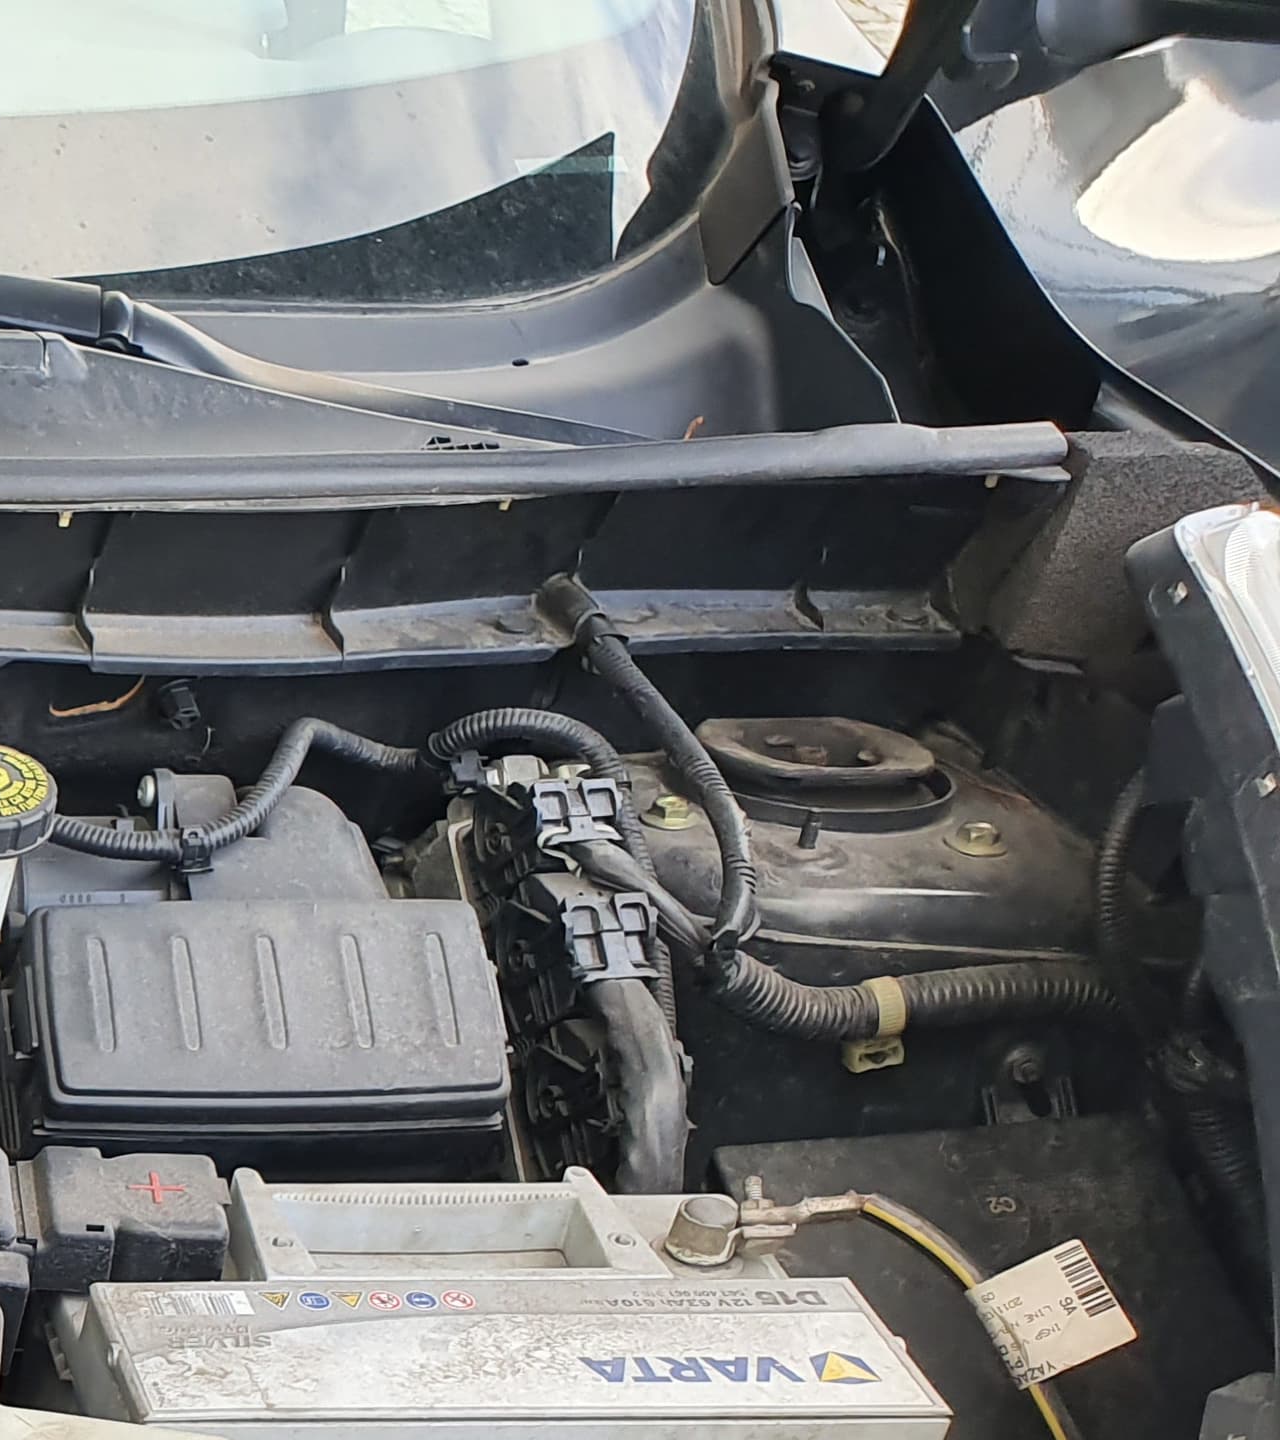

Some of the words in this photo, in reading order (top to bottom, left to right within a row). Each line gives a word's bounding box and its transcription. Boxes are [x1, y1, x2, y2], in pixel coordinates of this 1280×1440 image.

[755, 1290, 827, 1306] D15
[167, 1334, 272, 1350] SILVER
[578, 1356, 805, 1385] VARTA
